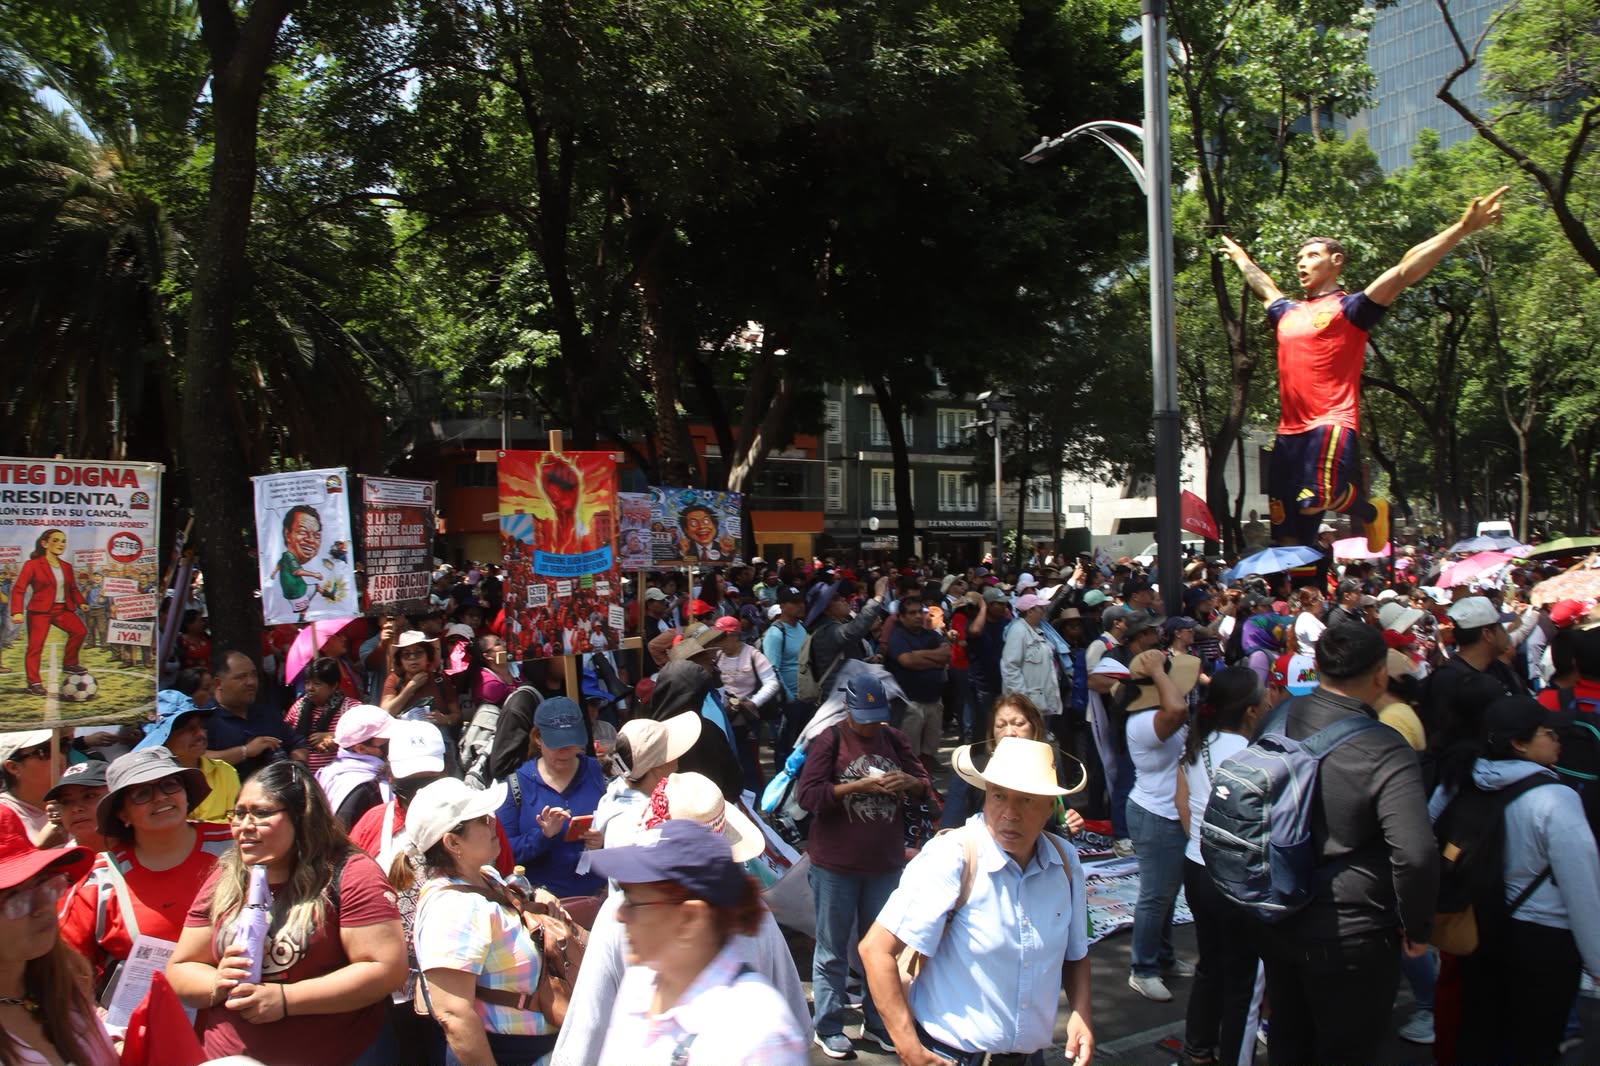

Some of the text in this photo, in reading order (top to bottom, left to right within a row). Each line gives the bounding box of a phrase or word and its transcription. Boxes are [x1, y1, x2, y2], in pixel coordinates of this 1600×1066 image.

[54, 465, 140, 488] DIGNA
[0, 490, 124, 508] RESIDENTA,
[16, 519, 86, 527] TRABAJADORES
[367, 513, 401, 525] SI LA SEP
[367, 524, 424, 536] SUSPENDE CLASES
[113, 540, 139, 550] CETEG
[367, 536, 380, 548] POR
[381, 536, 391, 547] UN
[373, 590, 383, 601] ES
[385, 589, 394, 601] LA
[117, 631, 142, 642] ¡YA!
